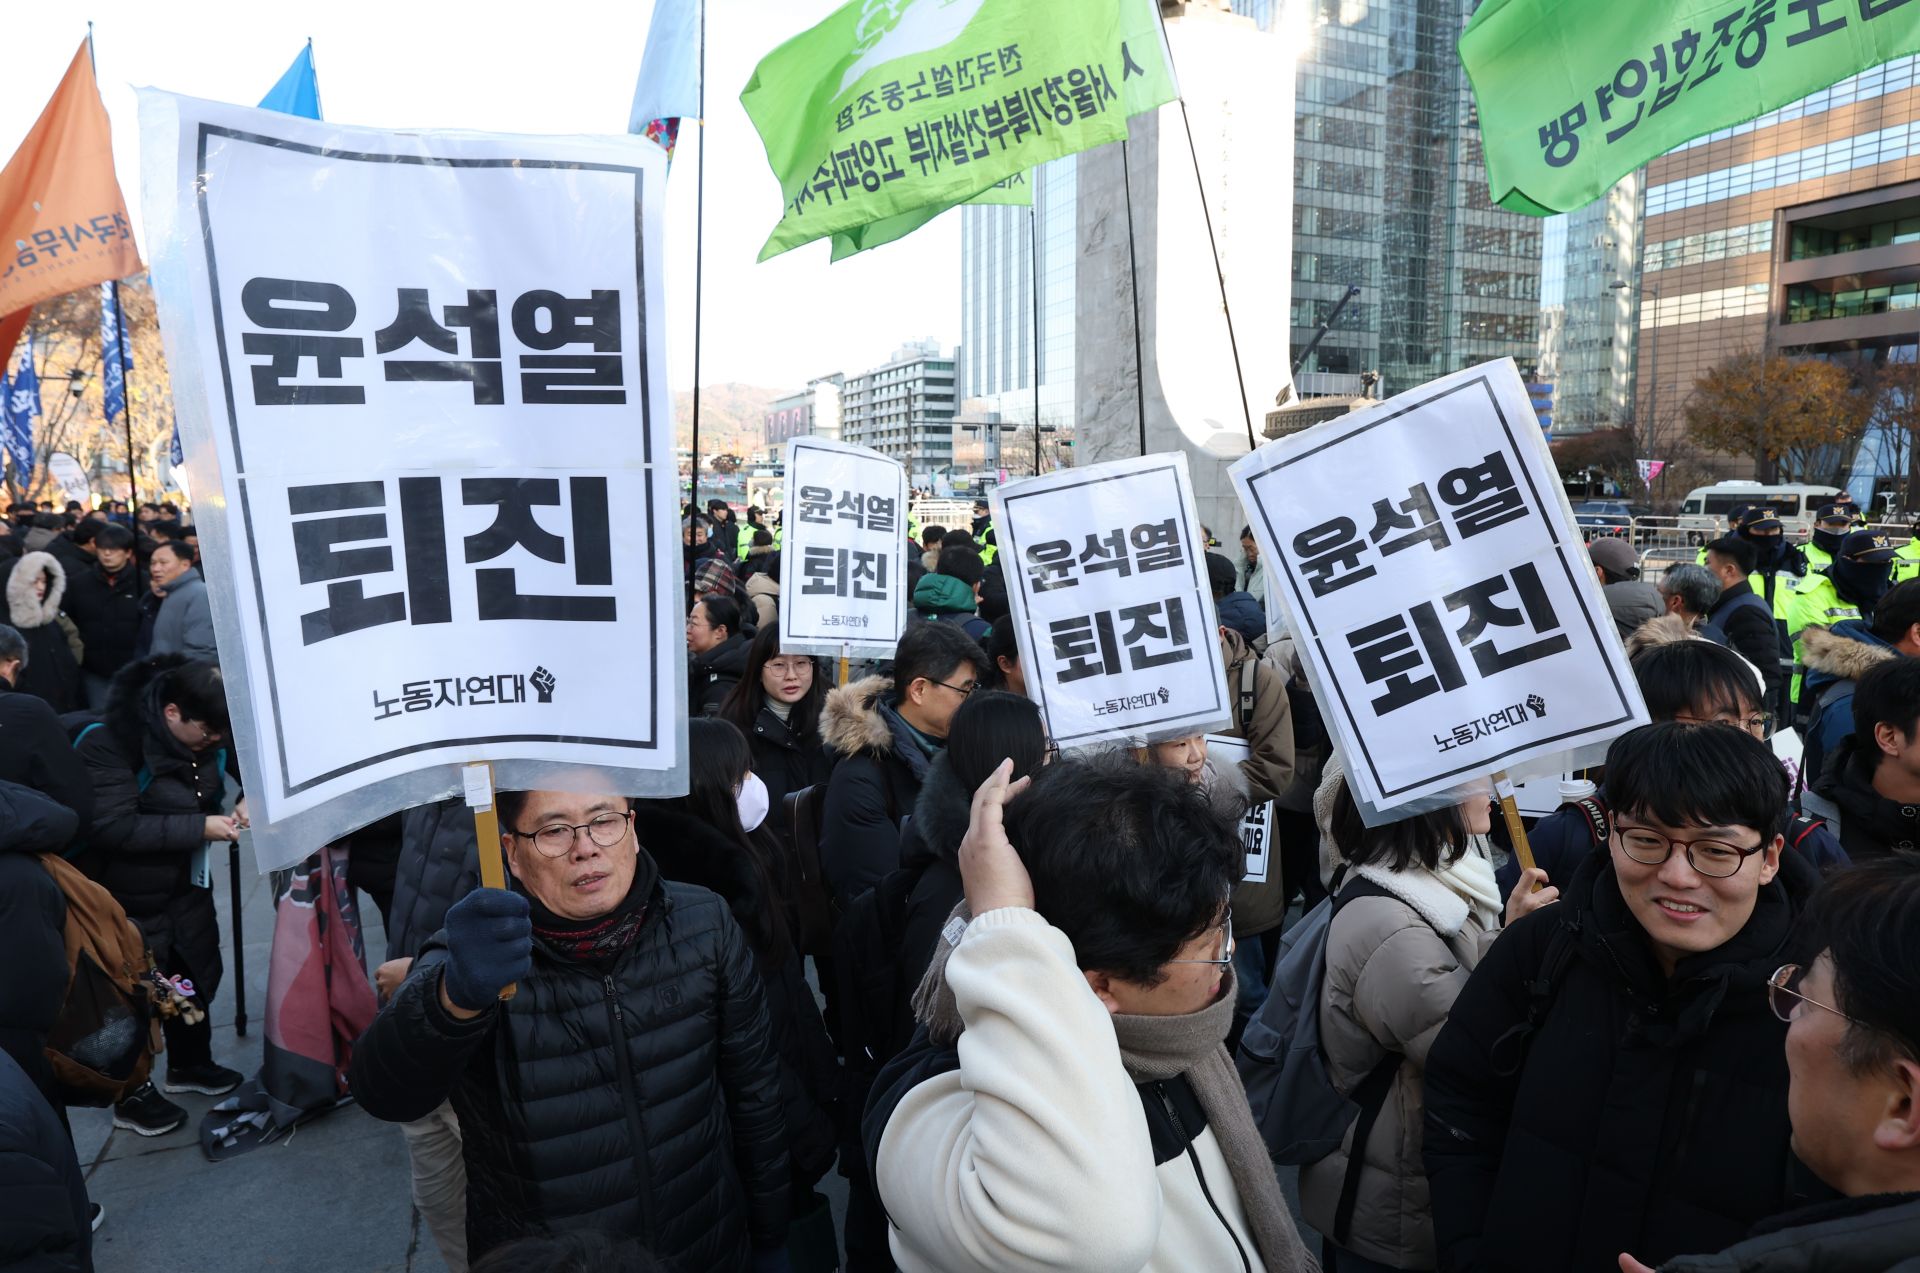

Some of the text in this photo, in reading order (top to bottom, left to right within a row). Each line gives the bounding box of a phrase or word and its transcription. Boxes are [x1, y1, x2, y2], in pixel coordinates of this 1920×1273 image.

[241, 276, 627, 406] 윤석열
[799, 485, 895, 533] 윤석열
[1292, 450, 1530, 598] 윤석열
[287, 476, 617, 646] 퇴진
[802, 546, 887, 601] 퇴진
[1026, 518, 1185, 593] 윤석열
[822, 614, 862, 628] 노동자연대
[1049, 597, 1193, 684] 퇴진
[1345, 562, 1572, 717] 퇴진
[373, 674, 526, 721] 노동자연대
[1093, 691, 1158, 716] 노동자연대
[1433, 706, 1528, 753] 노동자연대
[1580, 799, 1608, 841] Canon
